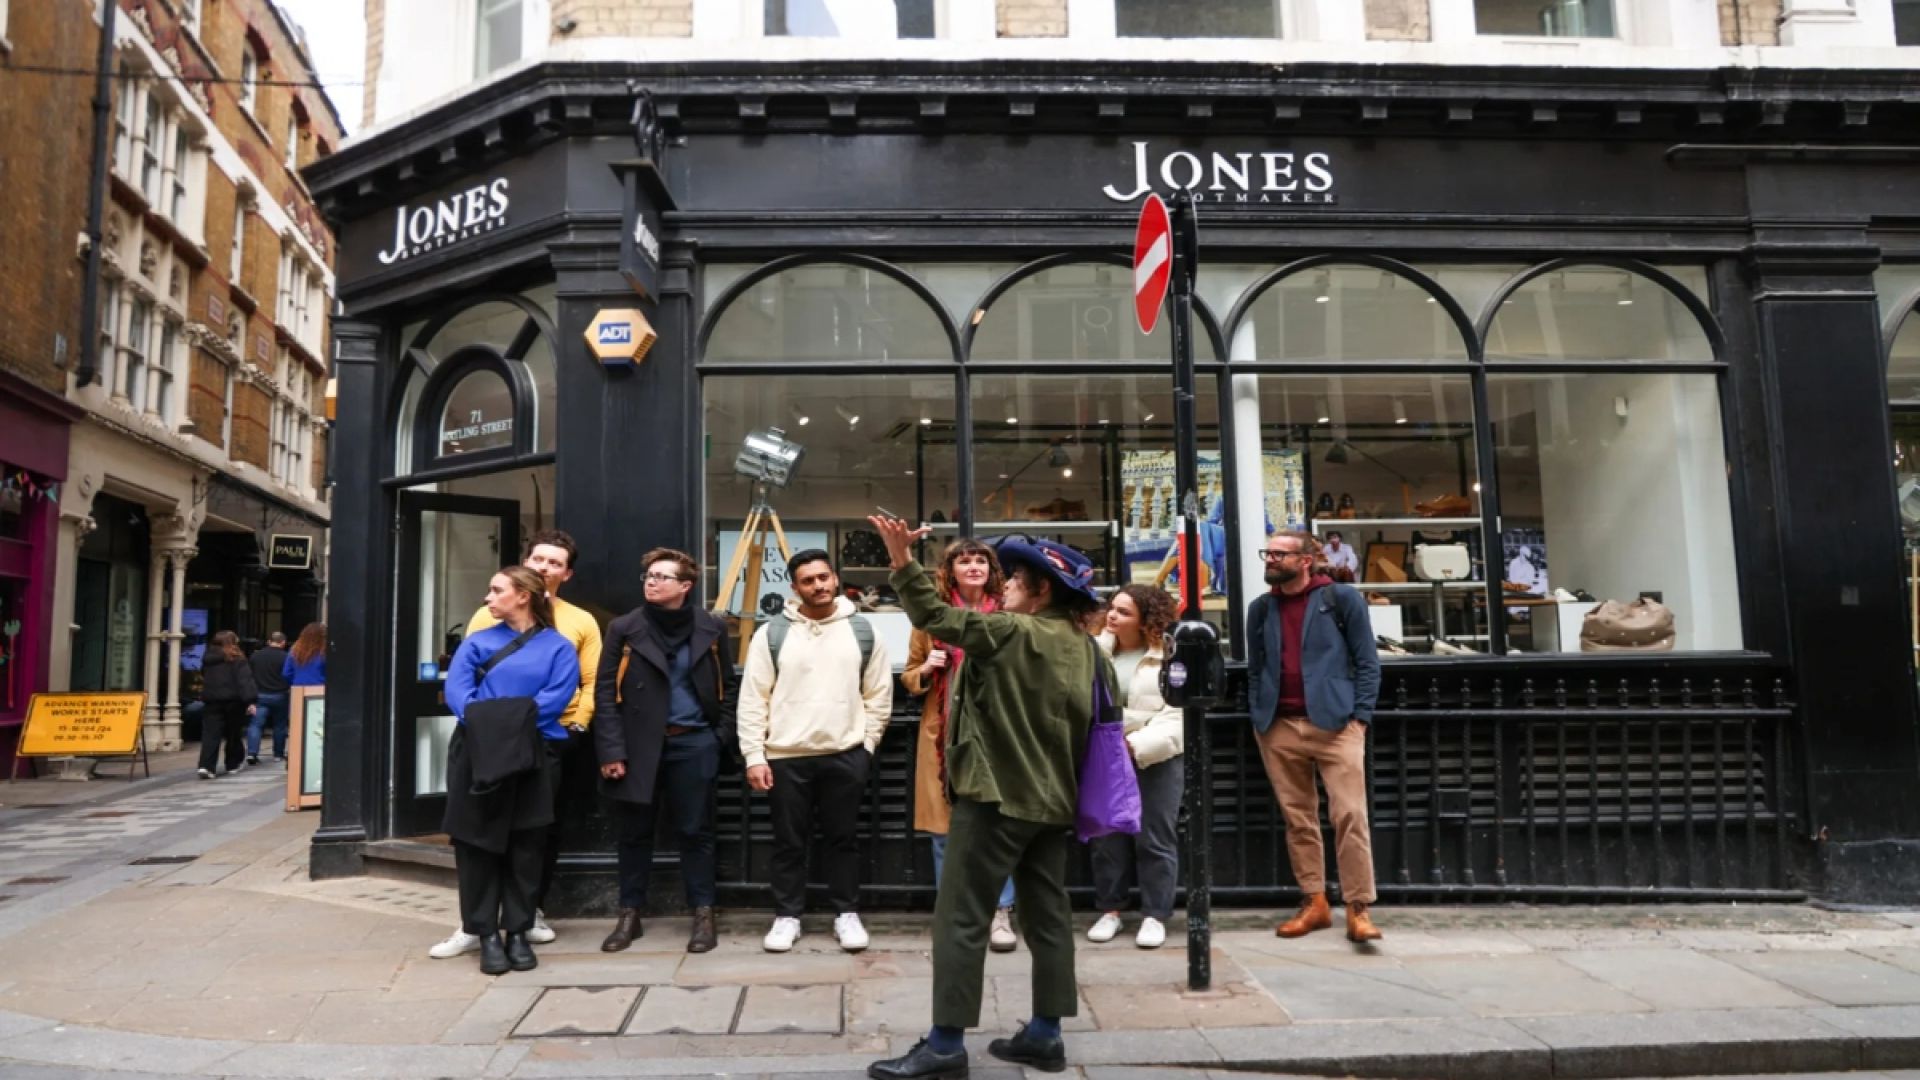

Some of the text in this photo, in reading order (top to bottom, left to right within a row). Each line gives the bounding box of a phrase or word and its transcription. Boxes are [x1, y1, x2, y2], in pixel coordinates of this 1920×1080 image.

[1102, 141, 1335, 201] JONES
[1169, 192, 1335, 203] OTMAKER
[378, 177, 510, 264] JONES
[600, 326, 630, 341] ADT
[470, 409, 483, 424] 71
